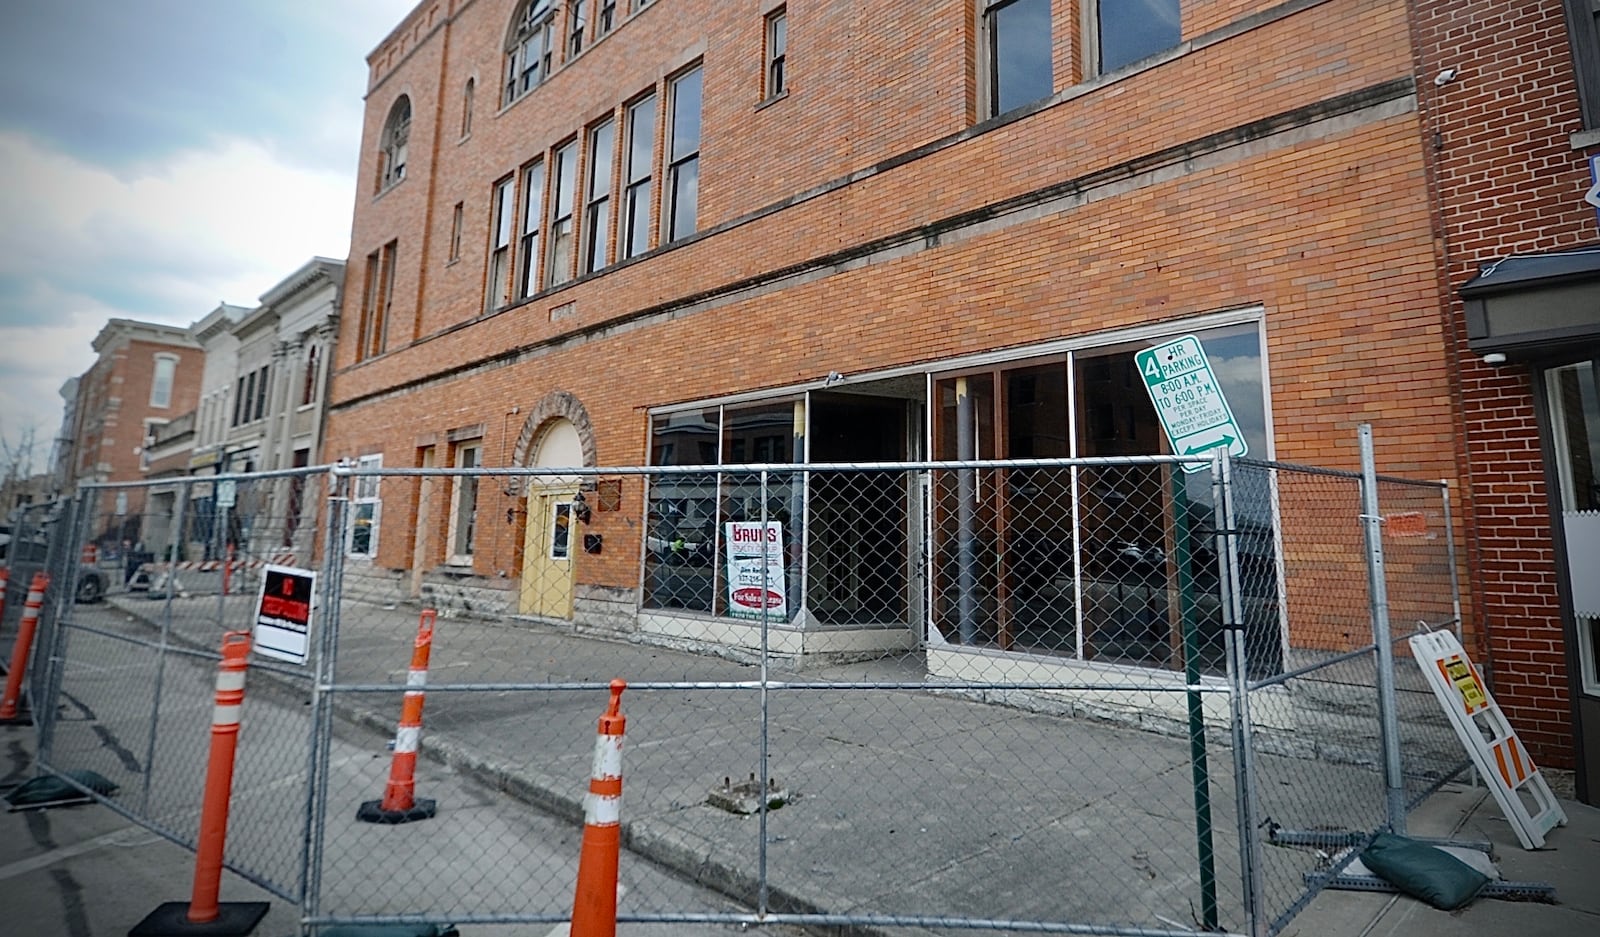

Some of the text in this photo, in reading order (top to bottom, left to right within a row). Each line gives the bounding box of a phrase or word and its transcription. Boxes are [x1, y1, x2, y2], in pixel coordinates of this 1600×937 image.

[1168, 344, 1186, 357] HR
[1144, 356, 1161, 379] 4
[1162, 354, 1202, 376] PARKING
[1160, 379, 1182, 395] 8:00
[1157, 396, 1172, 410] TO
[1175, 389, 1195, 405] 6:00
[1173, 397, 1208, 413] PER SPACE
[1180, 405, 1207, 418] PER DAY
[1171, 413, 1228, 436] EXCEPT HOLIDAYS
